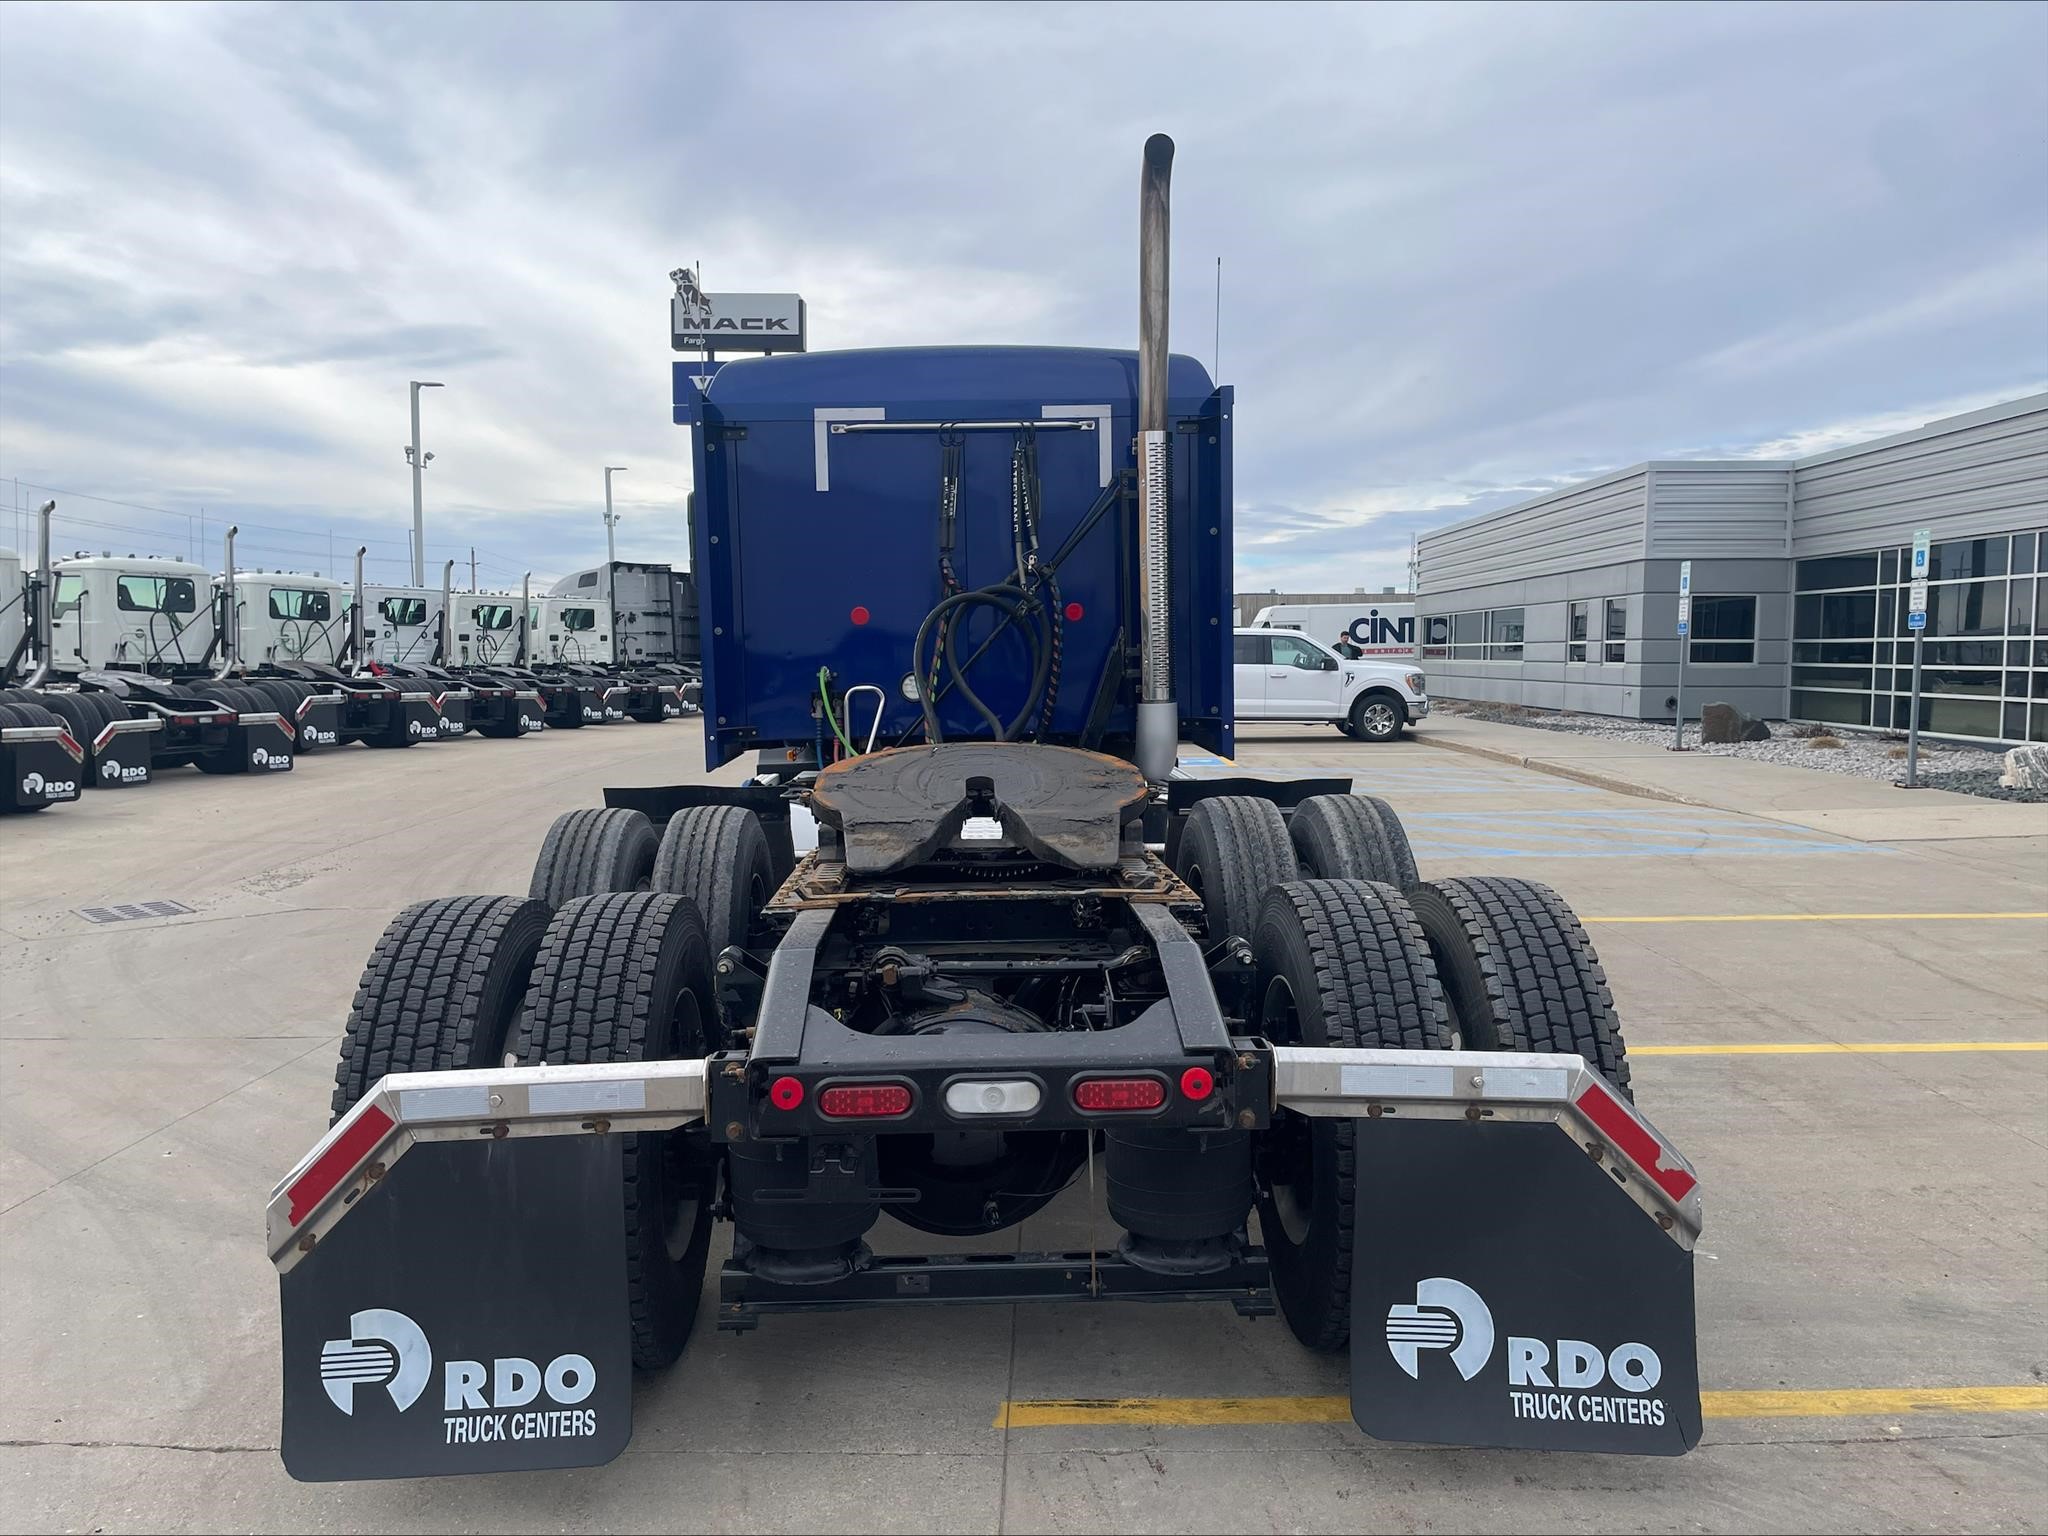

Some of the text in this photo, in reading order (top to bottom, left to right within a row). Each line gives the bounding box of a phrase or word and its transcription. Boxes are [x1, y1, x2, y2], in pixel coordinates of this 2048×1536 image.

[683, 318, 789, 330] MACK
[268, 755, 289, 764] RDO
[121, 766, 147, 777] RDO
[45, 781, 75, 793] RDO
[1507, 1336, 1662, 1393] RDO
[444, 1353, 597, 1411] RDO
[1509, 1391, 1666, 1426] TRUCK CENTERS
[443, 1408, 597, 1444] TRUCK CENTERS
